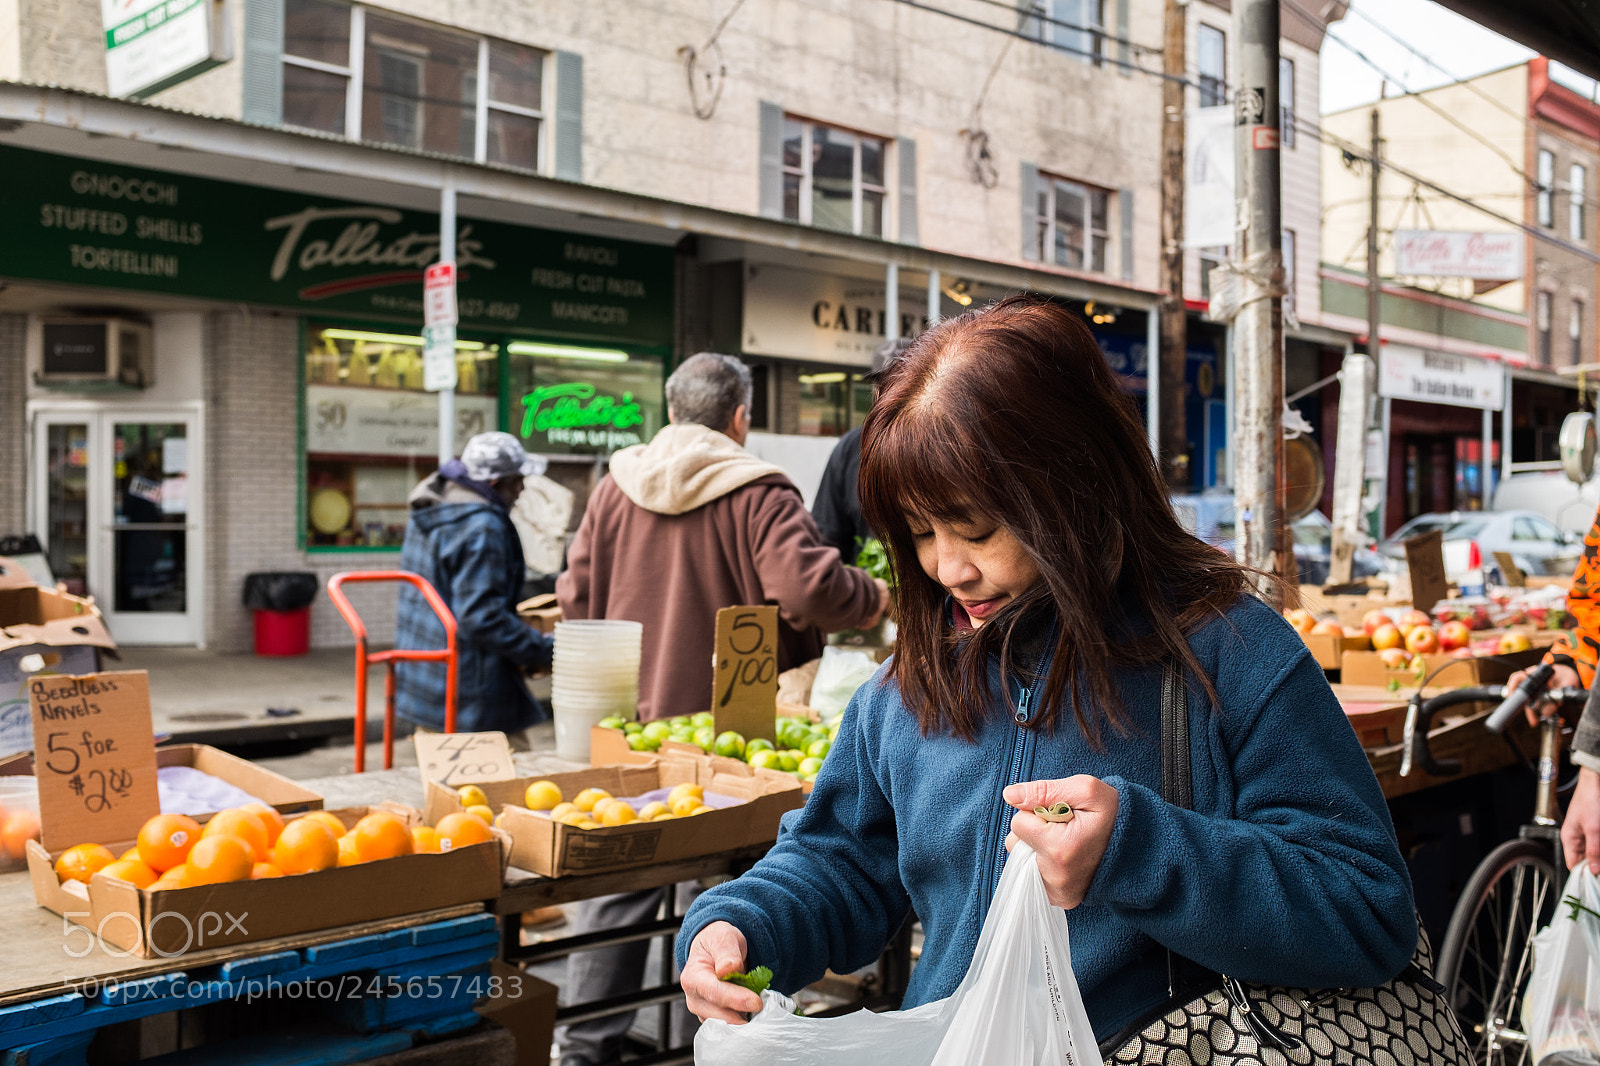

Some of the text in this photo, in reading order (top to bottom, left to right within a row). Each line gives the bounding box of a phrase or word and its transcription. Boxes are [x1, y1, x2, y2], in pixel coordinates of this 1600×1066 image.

[70, 170, 178, 206] GNOCCHI
[40, 203, 203, 245] STUFFED SHELLS
[69, 244, 178, 277] TORTELLINI
[315, 400, 347, 431] 50
[728, 613, 764, 655] 5
[46, 731, 80, 775] 5
